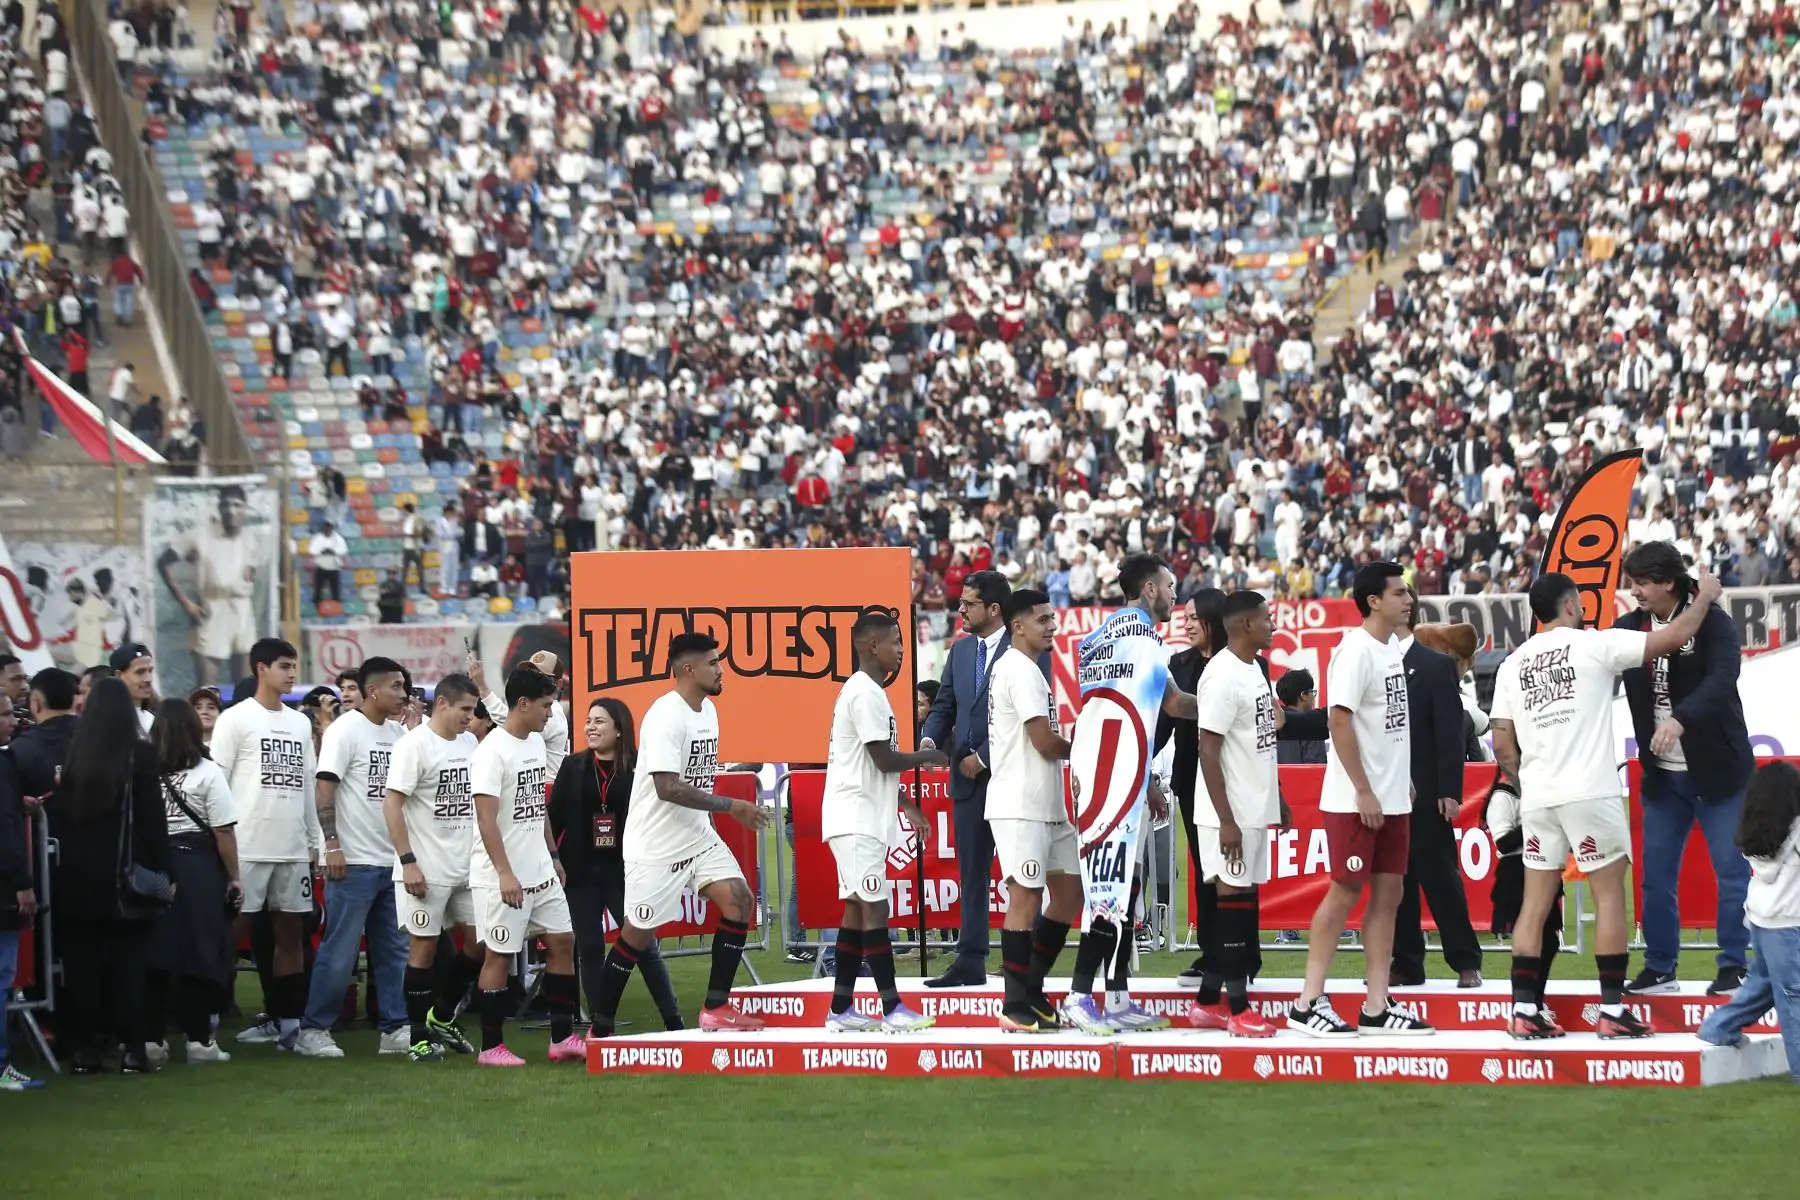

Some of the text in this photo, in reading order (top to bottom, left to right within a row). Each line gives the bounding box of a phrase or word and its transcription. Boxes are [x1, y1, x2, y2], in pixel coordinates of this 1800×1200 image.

[261, 738, 303, 756] GANA
[261, 772, 303, 788] 2025
[1085, 841, 1127, 883] VEGA
